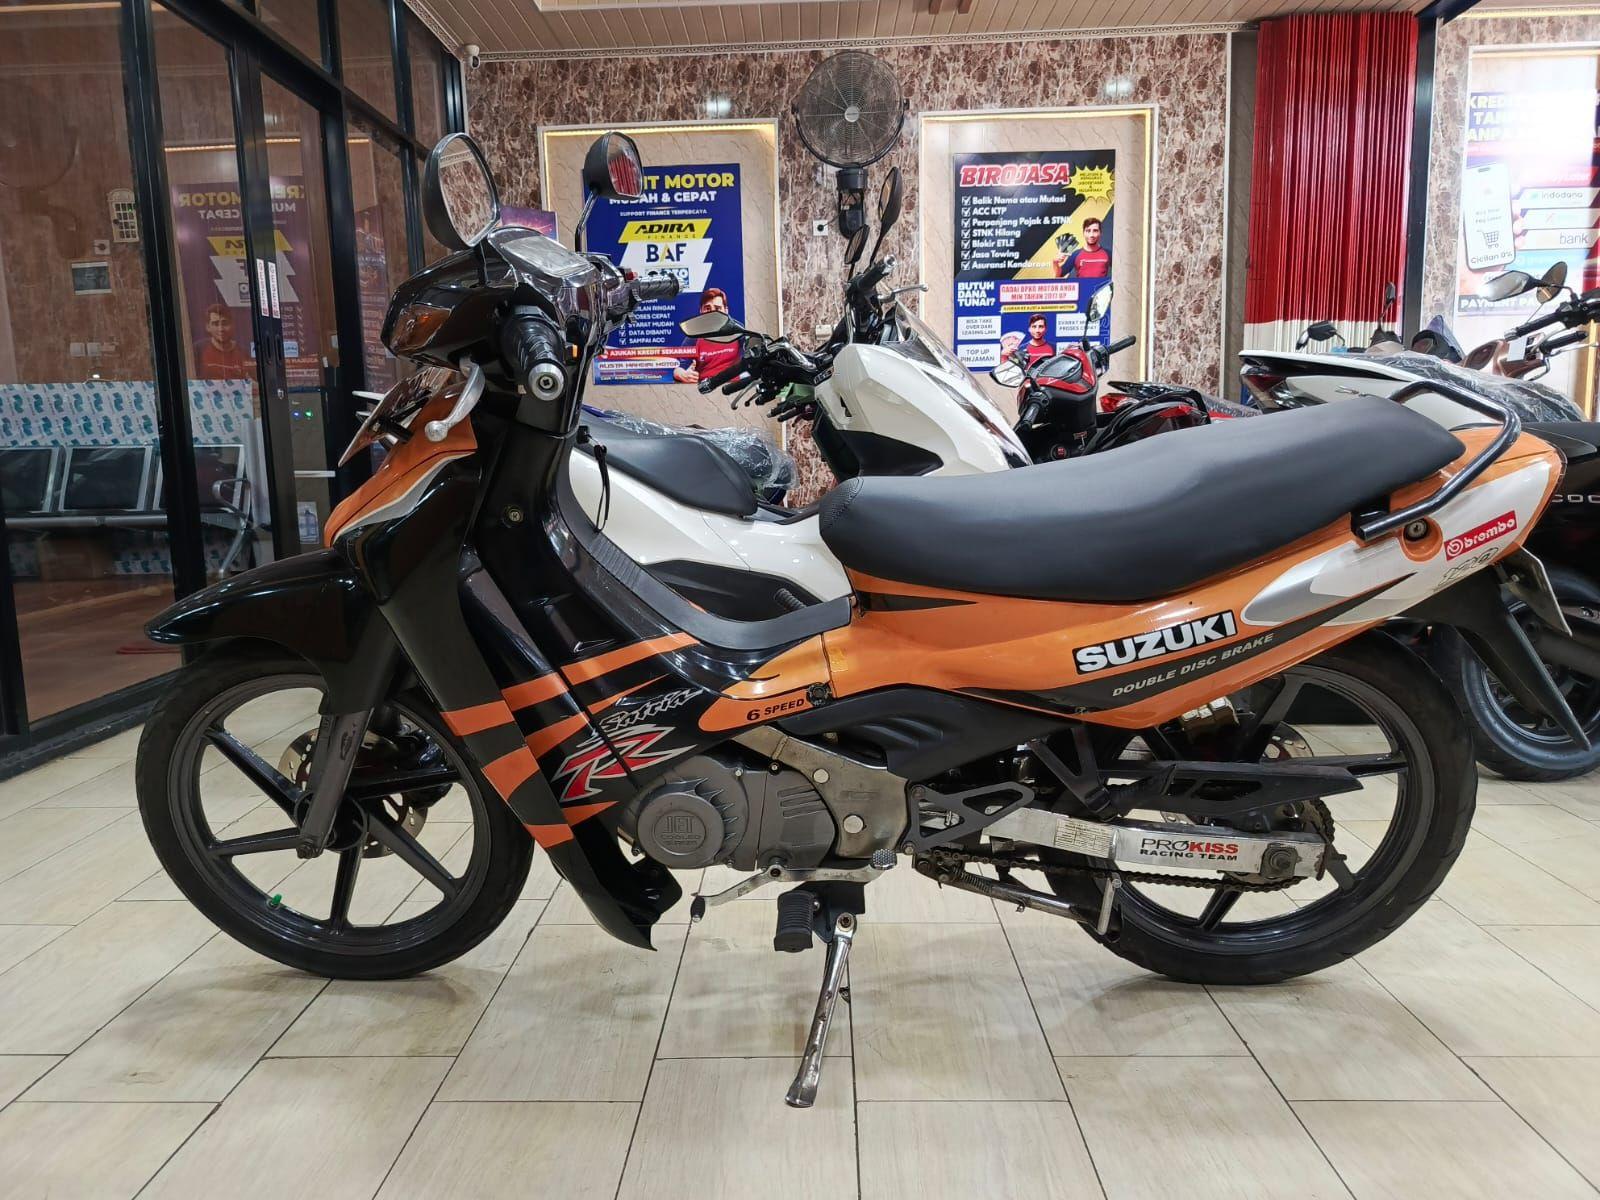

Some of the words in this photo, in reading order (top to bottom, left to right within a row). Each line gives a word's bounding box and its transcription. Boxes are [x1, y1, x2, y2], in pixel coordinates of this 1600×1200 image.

[960, 163, 1070, 187] BIROJASA
[664, 172, 734, 190] MOTOR
[661, 193, 671, 203] &
[673, 191, 717, 202] CEPAT
[972, 196, 992, 205] Balik
[993, 196, 1018, 204] Nama
[1039, 194, 1066, 203] Mutasi
[972, 207, 991, 215] ACC
[991, 206, 1007, 215] KTP
[972, 218, 1018, 227] Perpanjang
[1019, 217, 1041, 227] Pajak
[1043, 216, 1050, 225] &
[635, 223, 695, 234] ADIRA
[972, 229, 994, 238] STNK
[994, 229, 1021, 238] Hilang
[972, 240, 995, 248] Blokir
[996, 239, 1015, 247] ETLE
[1560, 232, 1589, 245] bank
[645, 243, 687, 263] BAF
[990, 250, 1020, 259] Towing
[972, 261, 1006, 269] Asuransi
[957, 281, 995, 291] BUTUH
[957, 290, 987, 299] DANA
[957, 297, 996, 307] TUNAI?
[1463, 518, 1515, 549] brembo
[1076, 612, 1236, 672] SUZUKI
[1112, 669, 1177, 696] DOUBLE
[1180, 655, 1217, 675] DISC
[1221, 632, 1275, 660] BRAKE
[746, 707, 760, 721] 6
[763, 698, 805, 716] SPEED
[1141, 837, 1239, 854] PROKISS
[1140, 849, 1194, 859] RACING
[1198, 852, 1238, 862] TEAM
